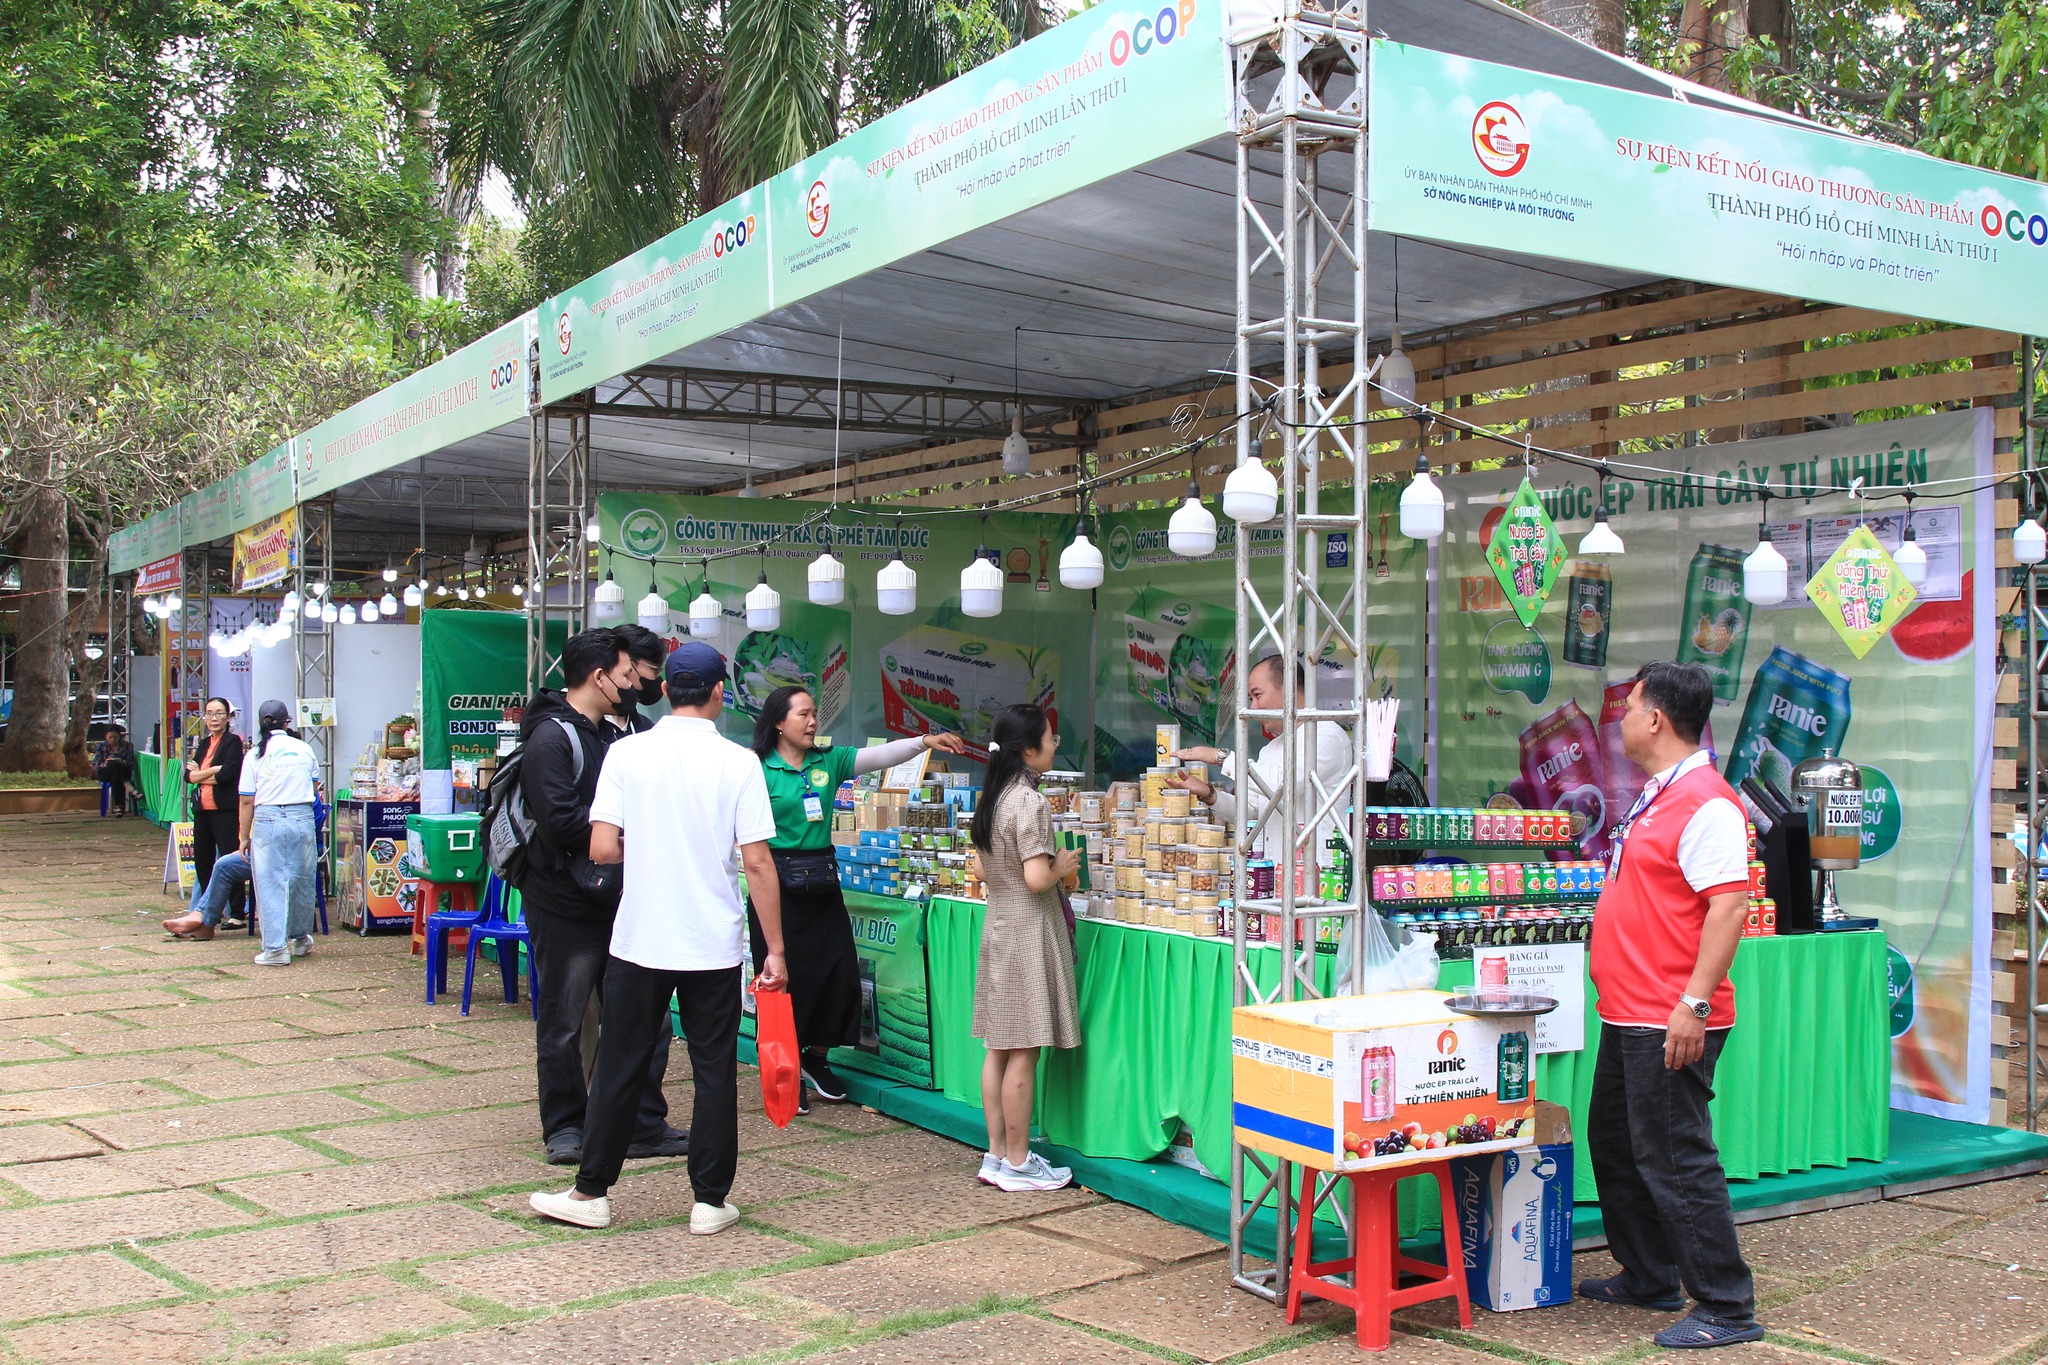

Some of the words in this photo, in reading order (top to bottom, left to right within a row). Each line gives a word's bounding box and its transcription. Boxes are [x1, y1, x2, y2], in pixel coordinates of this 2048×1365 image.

[866, 161, 879, 179] SỰ
[882, 147, 905, 170] KIỆN
[907, 134, 926, 159] KẾT
[928, 122, 949, 149] NỐI
[950, 112, 978, 138] GIAO
[980, 85, 1034, 123] THƯƠNG
[1036, 72, 1061, 97] SẢN
[1063, 50, 1104, 84] PHẨM
[1108, 0, 1197, 67] OCOP
[914, 157, 952, 186] THÀNH
[954, 139, 978, 169] PHỐ
[980, 131, 998, 157] HỒ
[1000, 122, 1021, 148] CHÍ
[1023, 108, 1059, 137] MINH
[1061, 93, 1087, 121] LẦN
[1089, 77, 1122, 109] THỨ
[1122, 77, 1128, 94] I
[977, 170, 1003, 191] nhập
[1004, 162, 1017, 179] và
[1019, 150, 1044, 174] Phát
[1616, 138, 1642, 161] SỰ
[1647, 143, 1691, 170] KIỆN
[1695, 151, 1731, 177] KẾT
[1734, 159, 1767, 185] NỐI
[1771, 170, 1814, 194] GIAO
[1818, 179, 1892, 210] THƯƠNG
[1895, 193, 1926, 216] SẢN
[1929, 200, 1975, 227] PHẨM
[1404, 166, 1418, 179] ỦY
[1419, 170, 1437, 183] BAN
[1439, 173, 1466, 188] NHÂN
[1467, 176, 1487, 191] DÂN
[1488, 181, 1518, 197] THÀNH
[1520, 184, 1539, 201] PHỐ
[1540, 189, 1553, 203] HỒ
[1554, 192, 1569, 206] CHÍ
[1570, 197, 1593, 210] MINH
[1423, 186, 1437, 200] SỞ
[1438, 188, 1467, 204] NÔNG
[1468, 193, 1503, 212] NGHIỆP
[1503, 198, 1518, 212] VÀ
[1518, 201, 1537, 217] MÔI
[1537, 205, 1575, 222] TRƯỜNG
[714, 215, 756, 258] OCOP
[1708, 192, 1771, 220] THÀNH
[1776, 205, 1811, 228] PHỐ
[1815, 209, 1841, 233] HỒ
[1844, 215, 1874, 239] CHÍ
[1877, 225, 1922, 249] MINH
[1924, 230, 1955, 255] LẦN
[1957, 237, 1991, 261] THỨ
[1993, 248, 1998, 263] I
[1809, 249, 1846, 273] nhập
[1849, 255, 1866, 271] và
[1868, 258, 1901, 280] Phát
[491, 359, 519, 391] OCOP
[383, 408, 408, 439] THÀNH
[454, 376, 479, 411] MINH
[1536, 480, 1593, 522] ƯỚC
[1603, 475, 1635, 517] ÉP
[1644, 465, 1704, 512] TRÁI
[1715, 460, 1771, 506] CÂY
[1780, 455, 1819, 505] TỰ
[1831, 441, 1928, 491] NHIÊN
[675, 514, 716, 542] CÔNG
[719, 522, 738, 542] TY
[740, 522, 781, 543] TNHH
[837, 520, 863, 546] PHÊ
[867, 524, 898, 548] TÂM
[900, 523, 930, 549] ĐỨC
[1135, 527, 1159, 551] CÔNG
[1216, 520, 1229, 545] CÀ
[1509, 524, 1534, 540] Nước
[1535, 520, 1547, 542] Ép
[680, 546, 696, 554] 163
[696, 546, 716, 555] Song
[785, 550, 806, 560] Quận
[860, 552, 874, 561] ĐT:
[874, 553, 893, 562] 0939
[909, 554, 925, 562] 355
[1327, 541, 1347, 554] ISO
[1509, 544, 1529, 562] Trái
[1529, 543, 1547, 564] Cây
[1836, 561, 1863, 582] Uống
[1867, 563, 1889, 580] Thử
[1839, 579, 1865, 598] Miễn
[1868, 581, 1886, 599] Phí
[899, 664, 915, 676] TRÀ
[936, 673, 955, 688] MỘC
[1791, 668, 1808, 681] JUICE
[1808, 676, 1826, 689] WITH
[450, 696, 492, 709] GIAN
[898, 678, 927, 701] TÂM
[927, 685, 961, 711] ĐỨC
[1831, 792, 1849, 806] NƯỚC
[1850, 791, 1857, 806] ÉP
[868, 918, 897, 946] ĐỨC
[1509, 951, 1532, 962] BẢNG
[1534, 949, 1549, 960] GIÁ
[1273, 1047, 1312, 1065] RHENUS
[1536, 1040, 1558, 1050] THÙNG
[1405, 1094, 1423, 1107] TỪ
[1424, 1089, 1455, 1106] THIÊN
[1457, 1087, 1488, 1102] NHIÊN
[1415, 1079, 1437, 1090] NƯỚC
[1437, 1079, 1448, 1089] ÉP
[1448, 1076, 1465, 1087] TRÁI
[1465, 1075, 1480, 1086] CÂY
[1463, 1166, 1480, 1269] AQUAFINA
[1523, 1197, 1539, 1262] AQUAFINA
[1503, 1292, 1510, 1303] 24
